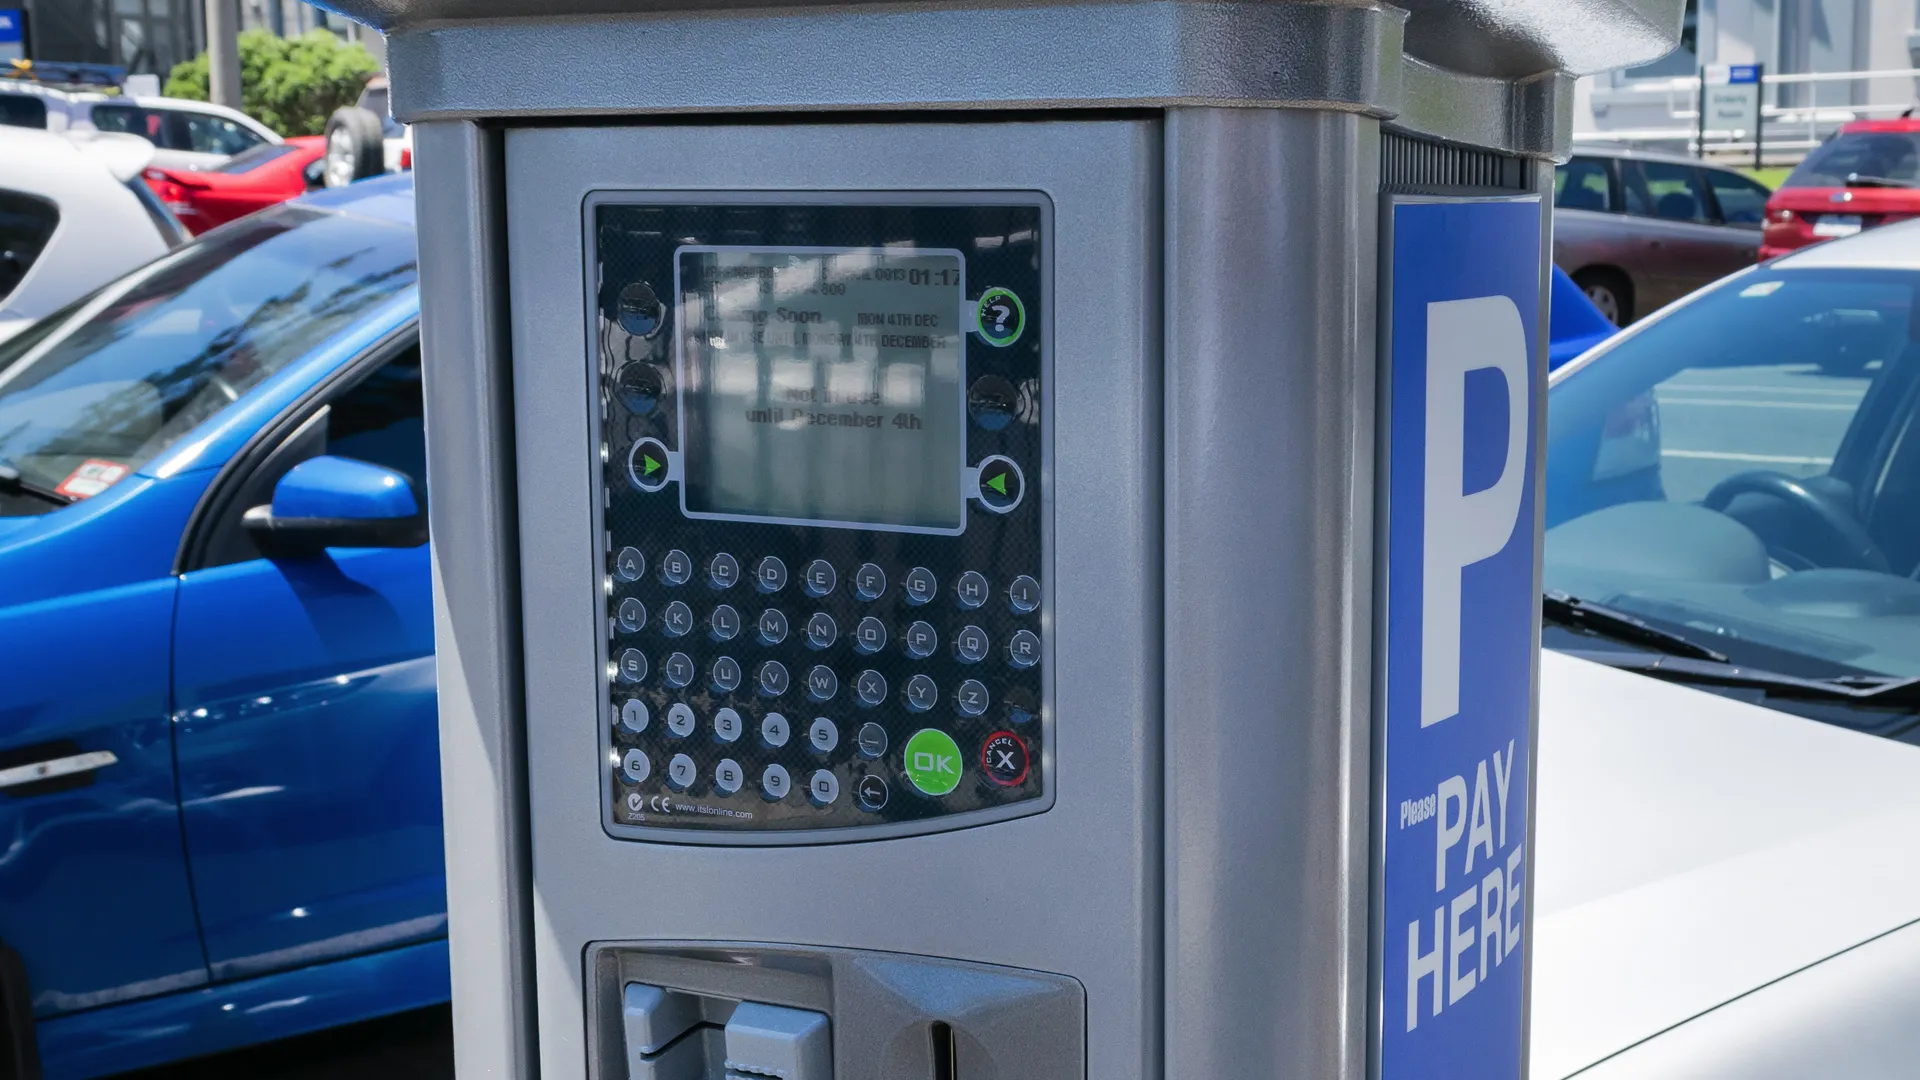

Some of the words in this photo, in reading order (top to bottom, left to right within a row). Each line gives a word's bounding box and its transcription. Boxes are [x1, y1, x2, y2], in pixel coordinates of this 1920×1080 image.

[908, 268, 960, 286] 01:17
[776, 306, 822, 324] Soon
[981, 295, 1001, 317] HELP
[857, 312, 885, 326] MON
[887, 313, 912, 327] 4TH
[914, 313, 939, 328] DEC
[881, 334, 946, 349] DECEMBER
[745, 407, 784, 424] until
[791, 408, 884, 429] December
[892, 412, 923, 430] 4th
[1421, 294, 1529, 728] P
[625, 558, 636, 570] A
[671, 561, 682, 574] B
[718, 564, 729, 577] C
[766, 568, 778, 580] D
[815, 571, 826, 585] E
[865, 576, 876, 588] F
[914, 579, 926, 592] G
[966, 583, 979, 596] H
[627, 609, 636, 621] J
[673, 612, 683, 625] K
[720, 616, 730, 629] L
[766, 620, 779, 633] M
[816, 624, 827, 637] N
[865, 629, 877, 641] O
[916, 633, 927, 645] P
[966, 637, 979, 652] Q
[1019, 641, 1031, 655] R
[628, 659, 638, 671] S
[674, 663, 684, 675] T
[721, 667, 731, 680] U
[767, 672, 779, 684] V
[814, 676, 829, 689] W
[866, 681, 877, 694] X
[915, 686, 927, 699] Y
[968, 691, 979, 704] Z
[630, 710, 637, 722] 1
[675, 714, 685, 726] 2
[722, 719, 733, 731] 3
[769, 724, 780, 736] 4
[818, 729, 829, 741] 5
[914, 751, 955, 775] OK
[986, 737, 1014, 765] CANCEL
[996, 750, 1016, 770] X
[631, 759, 641, 771] 6
[676, 764, 686, 776] 7
[723, 769, 734, 782] 8
[770, 775, 781, 787] 9
[675, 803, 753, 819] www.itslonline.com
[1400, 793, 1437, 830] Please
[1436, 738, 1515, 893] PAY
[1406, 843, 1522, 1033] HERE
